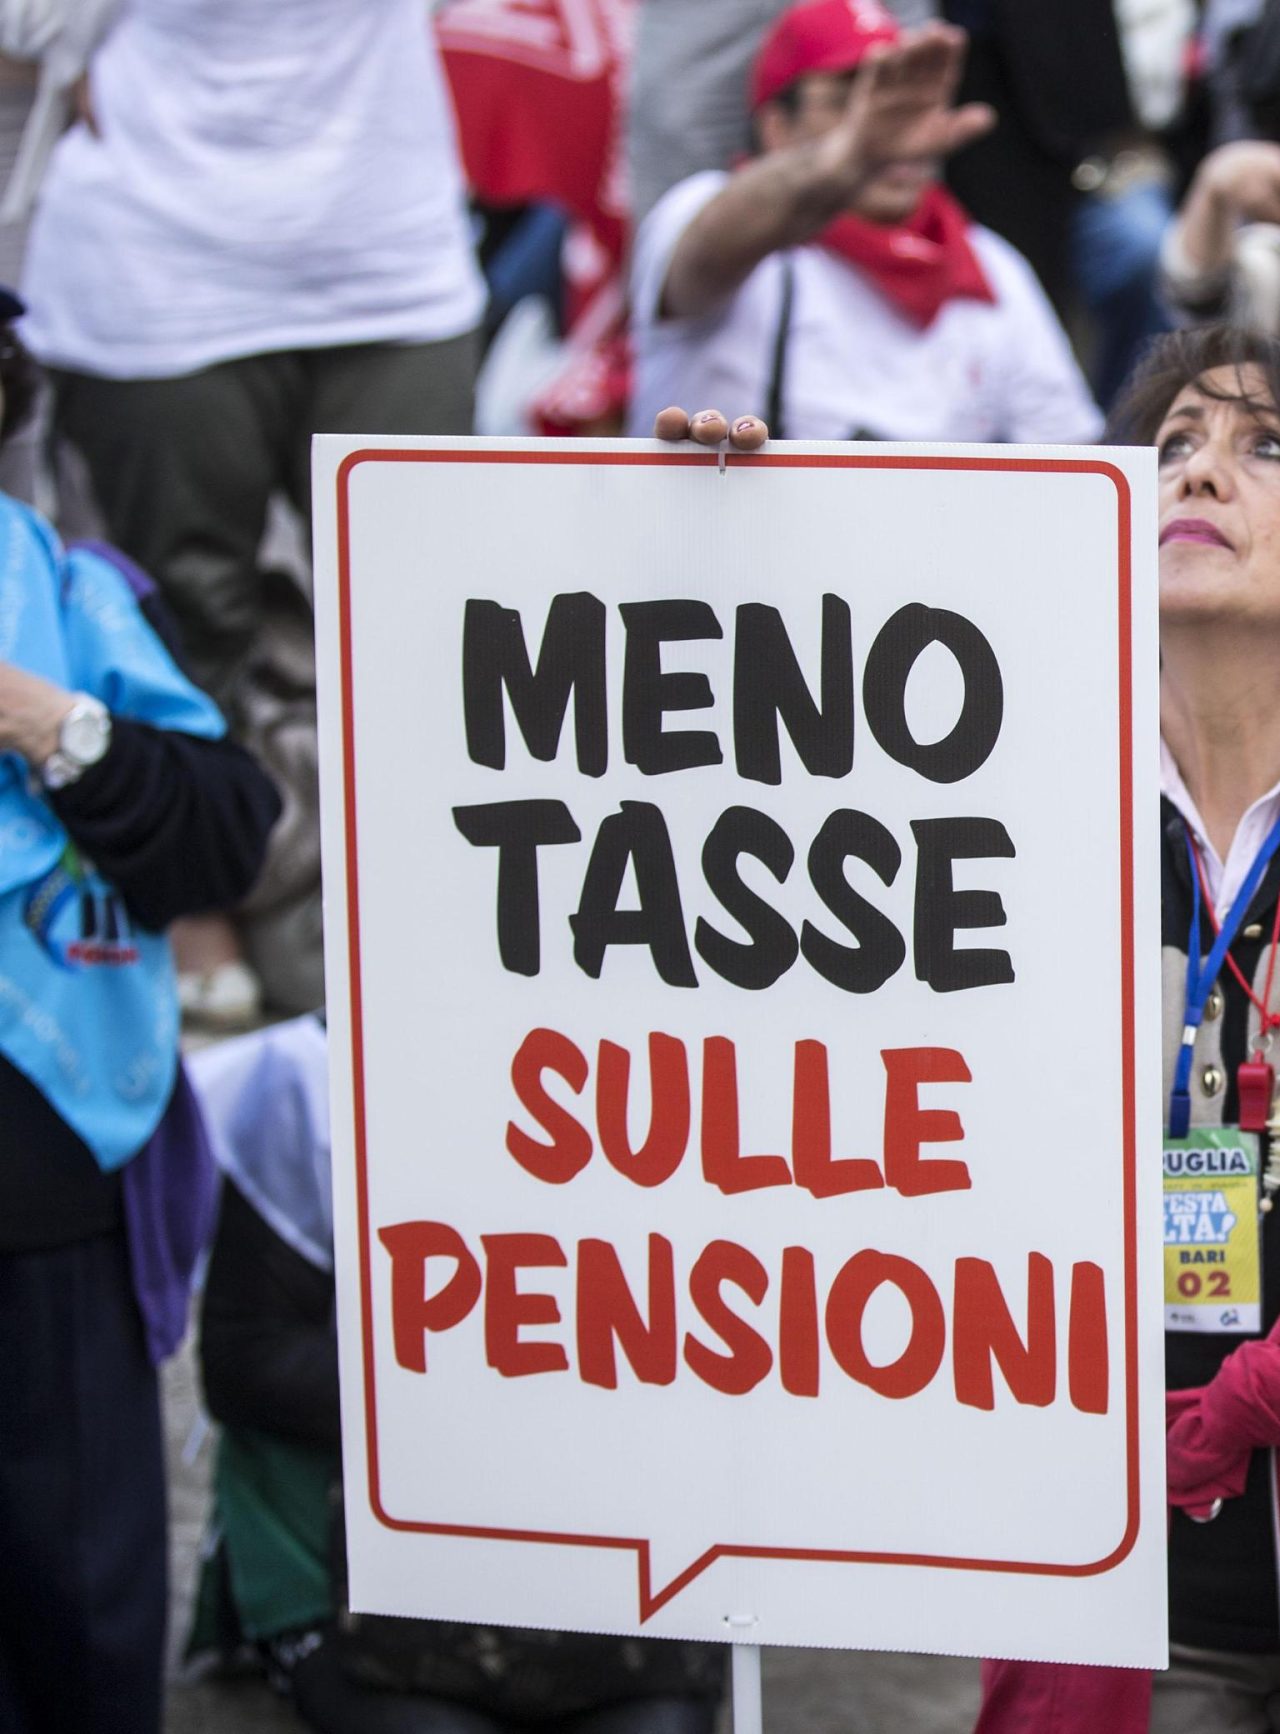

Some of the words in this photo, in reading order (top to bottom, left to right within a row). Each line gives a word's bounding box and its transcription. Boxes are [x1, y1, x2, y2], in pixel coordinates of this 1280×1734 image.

[463, 592, 1003, 785] MENO
[452, 799, 1015, 993] TASSE
[507, 1029, 971, 1198] SULLE
[1163, 1151, 1247, 1174] UGLIA
[379, 1221, 1108, 1413] PENSIONI
[1179, 1251, 1225, 1265] BARI
